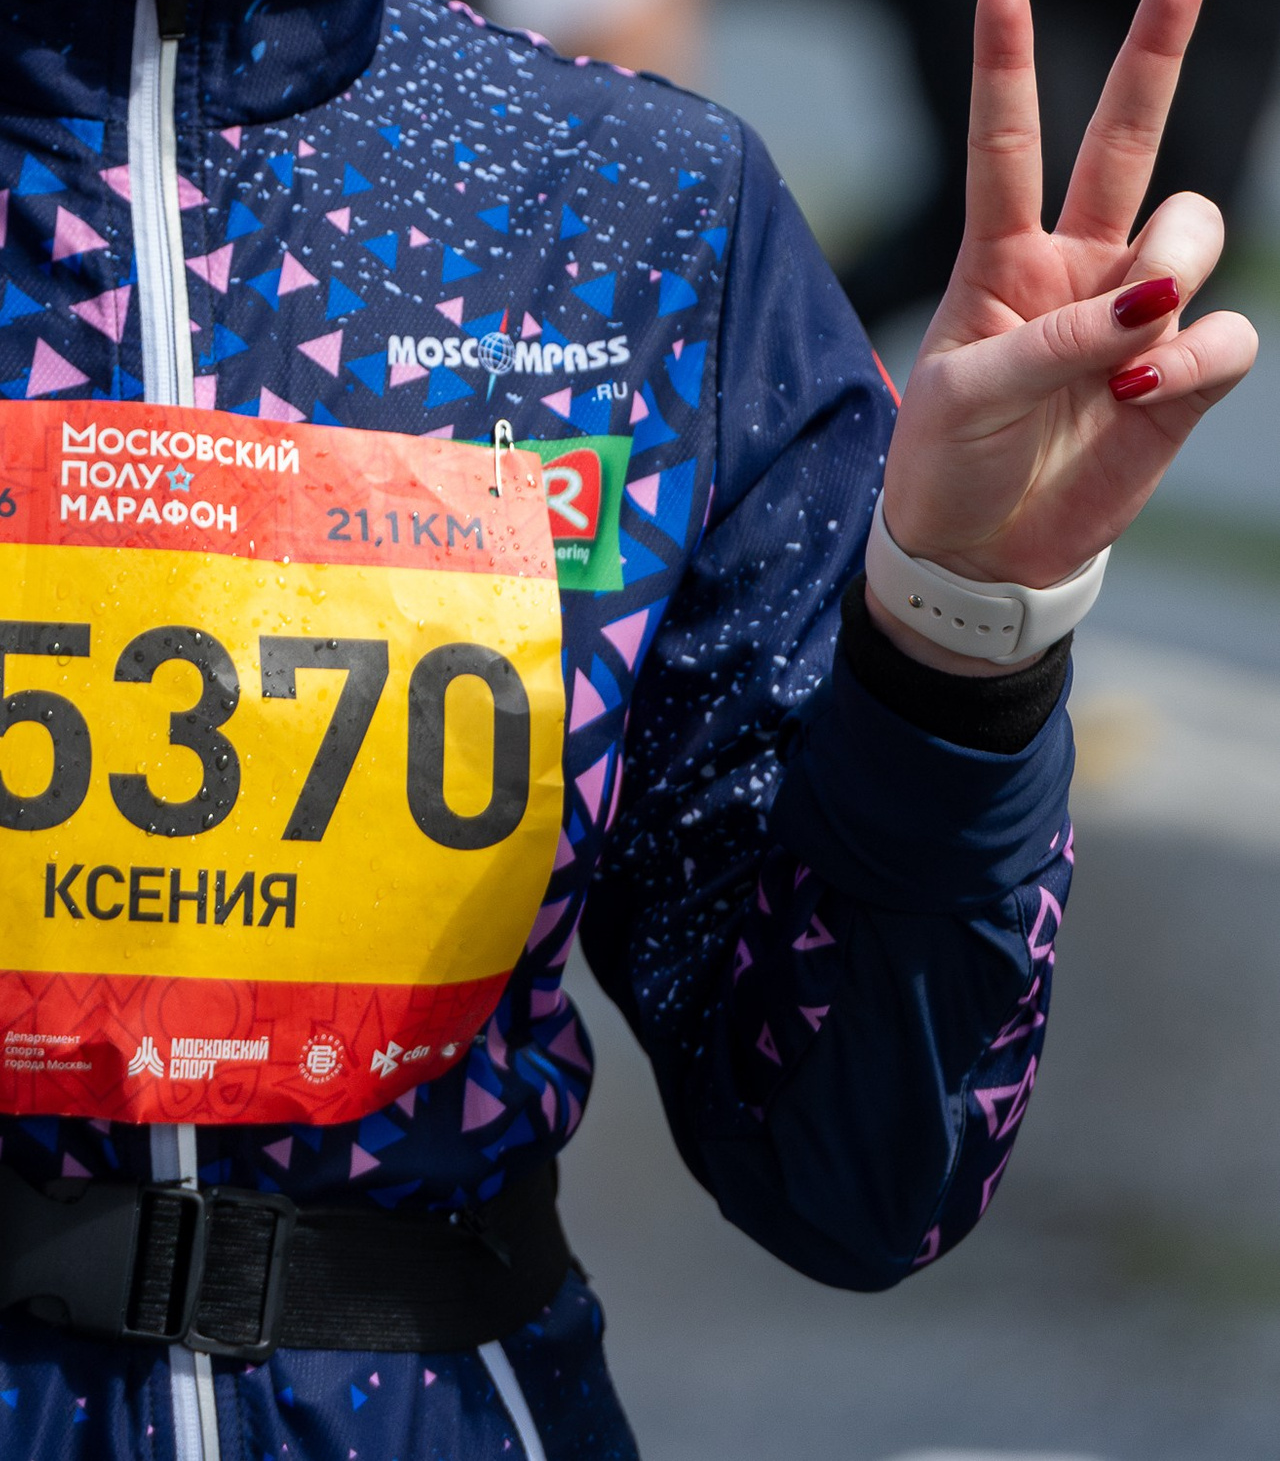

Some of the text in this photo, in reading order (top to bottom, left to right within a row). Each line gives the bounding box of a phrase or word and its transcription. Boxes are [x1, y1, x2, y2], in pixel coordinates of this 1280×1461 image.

[591, 381, 629, 402] .RU
[61, 420, 300, 474] МОСКОВСКИЙ
[61, 460, 164, 490] ПОЛУ
[60, 493, 238, 533] МАРАФОН
[554, 543, 590, 565] ering
[43, 862, 298, 929] КСЕНИЯ
[4, 1031, 81, 1044] Департамент
[170, 1036, 270, 1060] МОСКОВСКИЙ
[4, 1045, 45, 1057] спорта
[4, 1059, 93, 1070] города Москвы
[170, 1059, 218, 1080] СПОРТ
